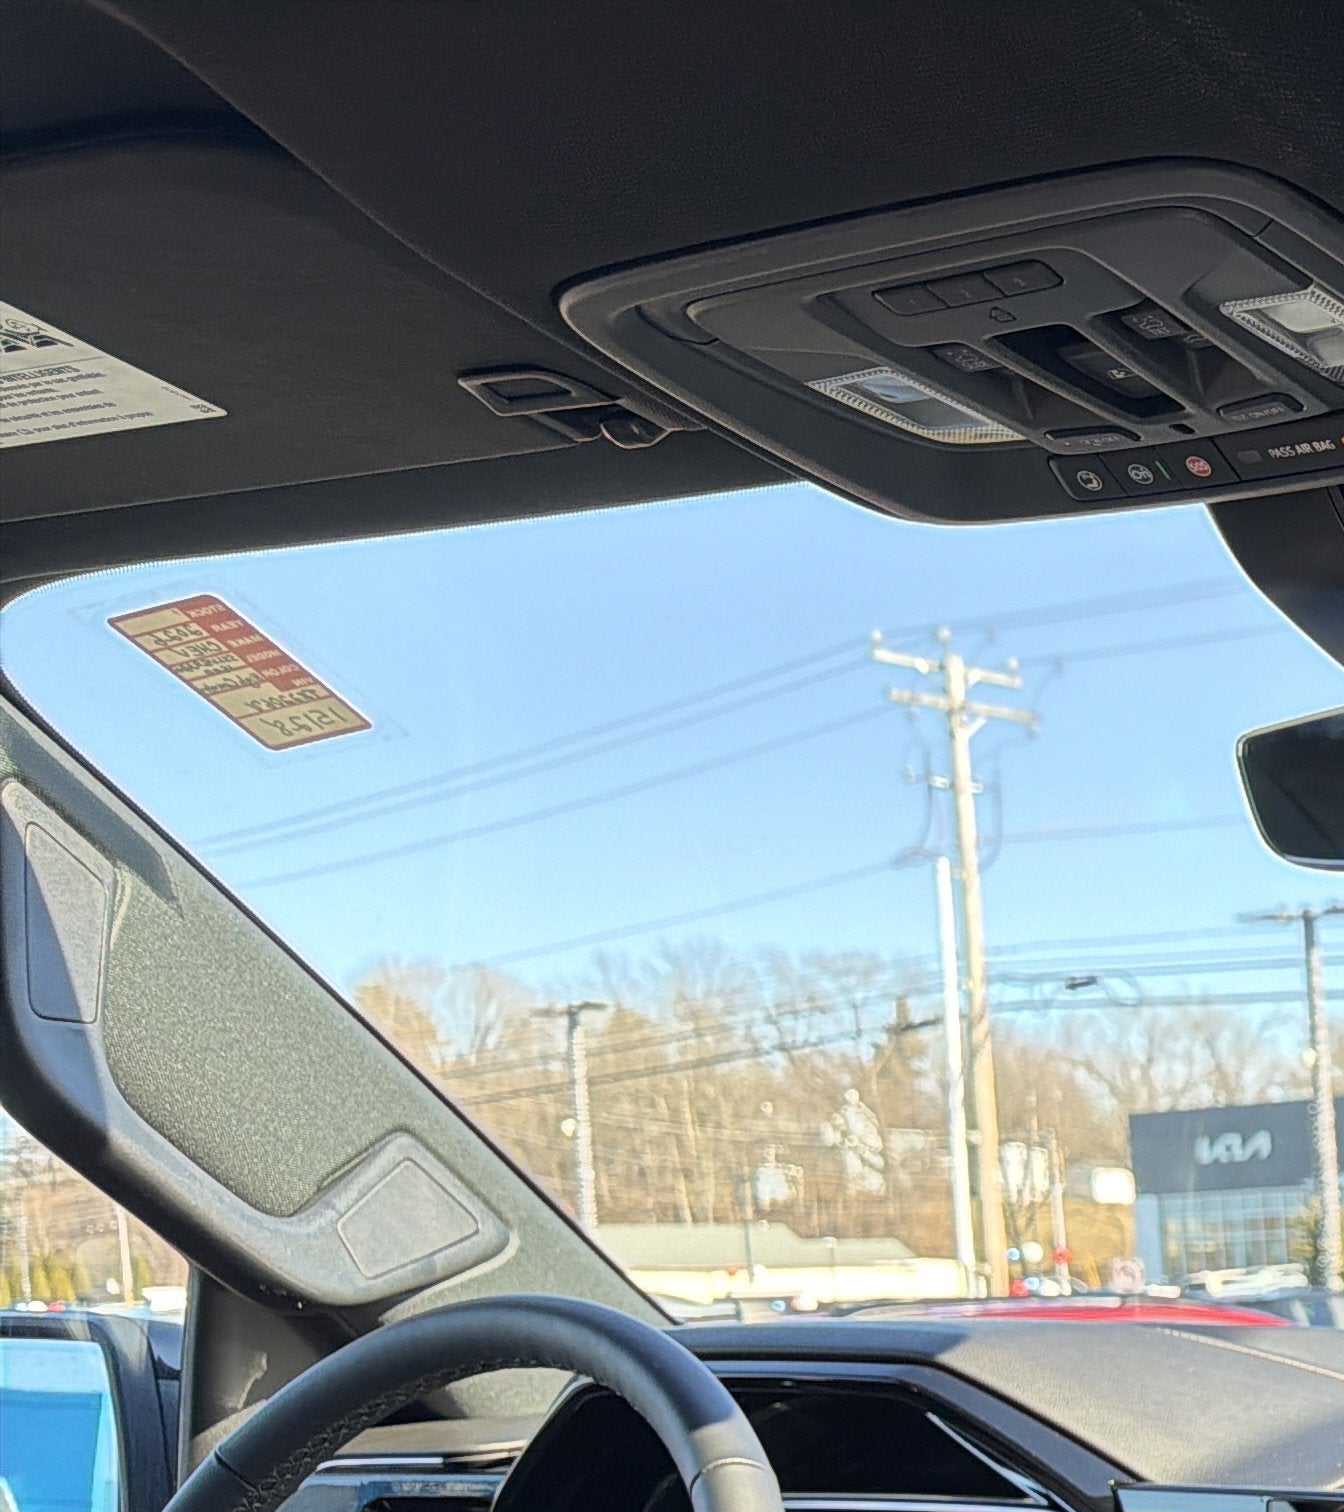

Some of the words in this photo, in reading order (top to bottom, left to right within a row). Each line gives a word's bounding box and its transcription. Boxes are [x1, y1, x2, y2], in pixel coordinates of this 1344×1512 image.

[1268, 446, 1296, 459] PASS
[1296, 443, 1313, 456] AIR
[1312, 440, 1336, 453] BAG
